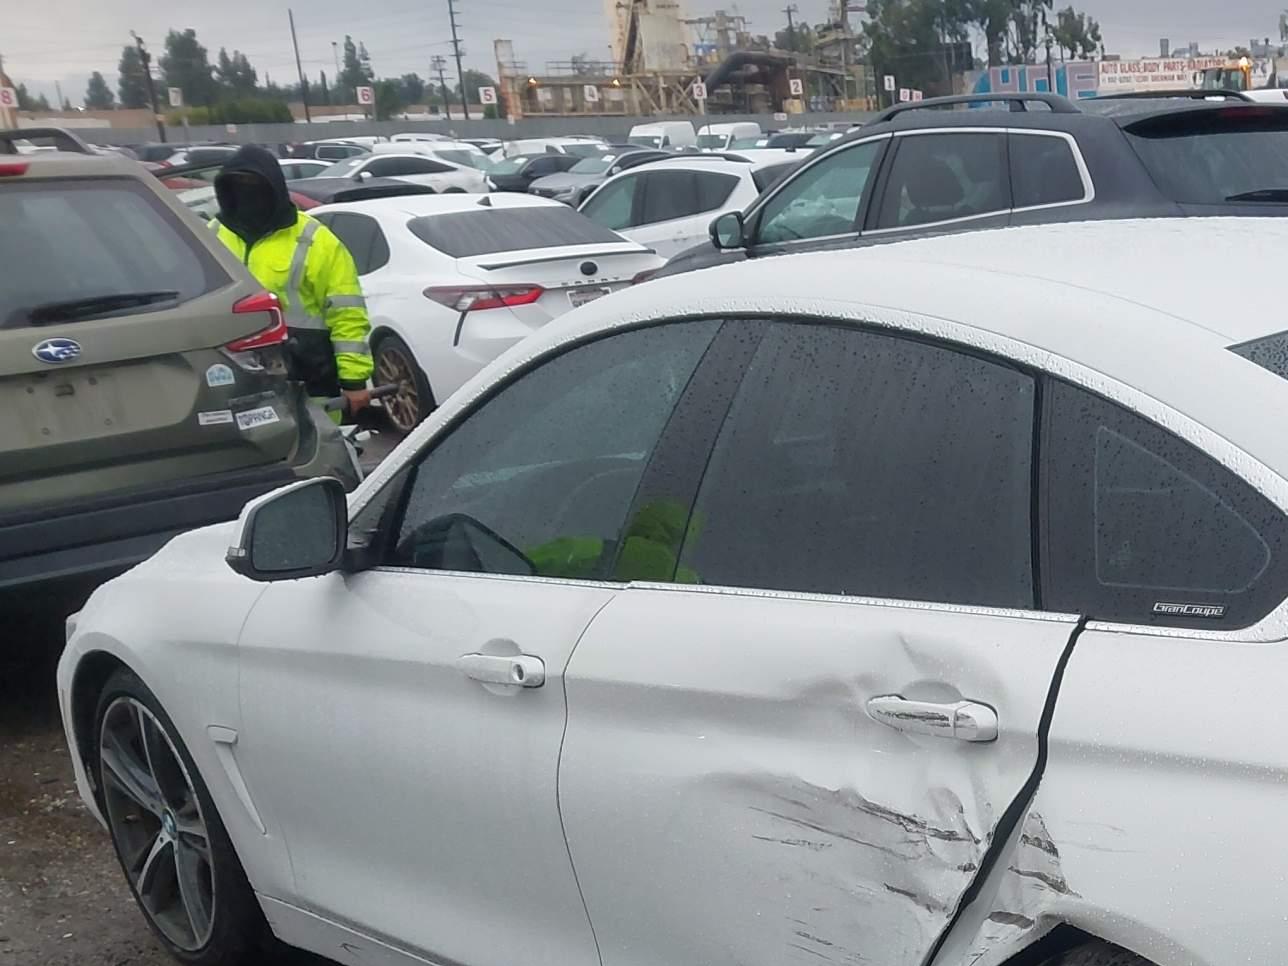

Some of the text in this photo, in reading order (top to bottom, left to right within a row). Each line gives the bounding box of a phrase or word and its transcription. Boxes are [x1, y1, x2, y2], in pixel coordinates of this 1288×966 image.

[1101, 63, 1118, 74] AUTO
[792, 82, 801, 93] 2
[886, 77, 893, 89] 1
[1, 90, 11, 105] 8
[361, 89, 370, 102] 6
[483, 89, 493, 102] 5
[696, 87, 703, 97] 3
